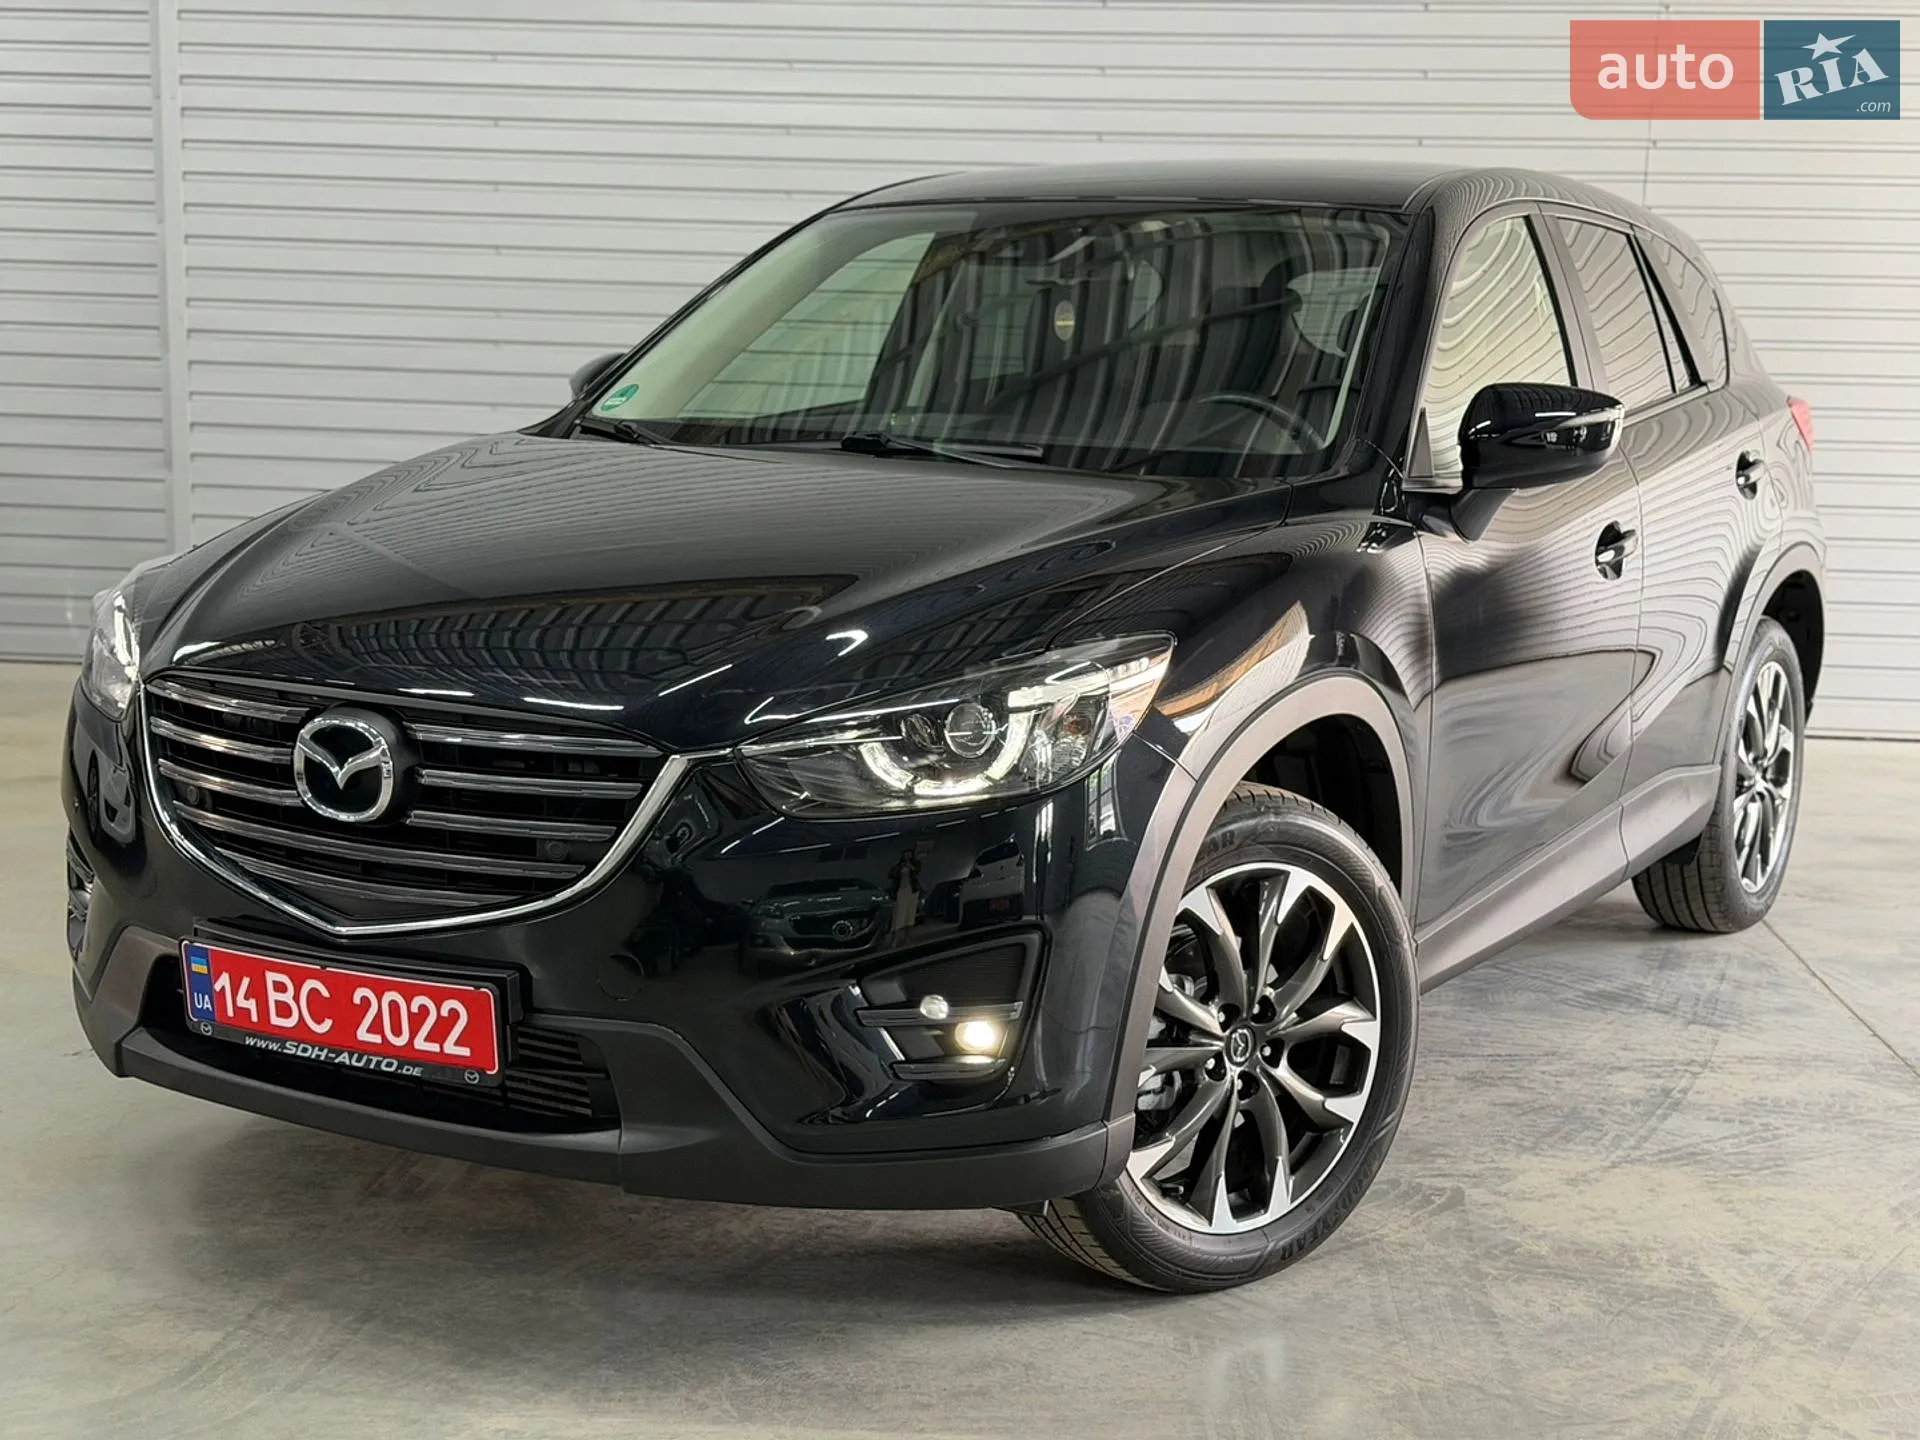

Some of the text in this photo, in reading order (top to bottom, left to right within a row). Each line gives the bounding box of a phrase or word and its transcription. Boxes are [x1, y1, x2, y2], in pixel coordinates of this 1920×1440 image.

[194, 993, 213, 1011] UA
[213, 970, 471, 1057] 14 BC 2022
[245, 1036, 424, 1077] www.SDH-AUTO.DE
